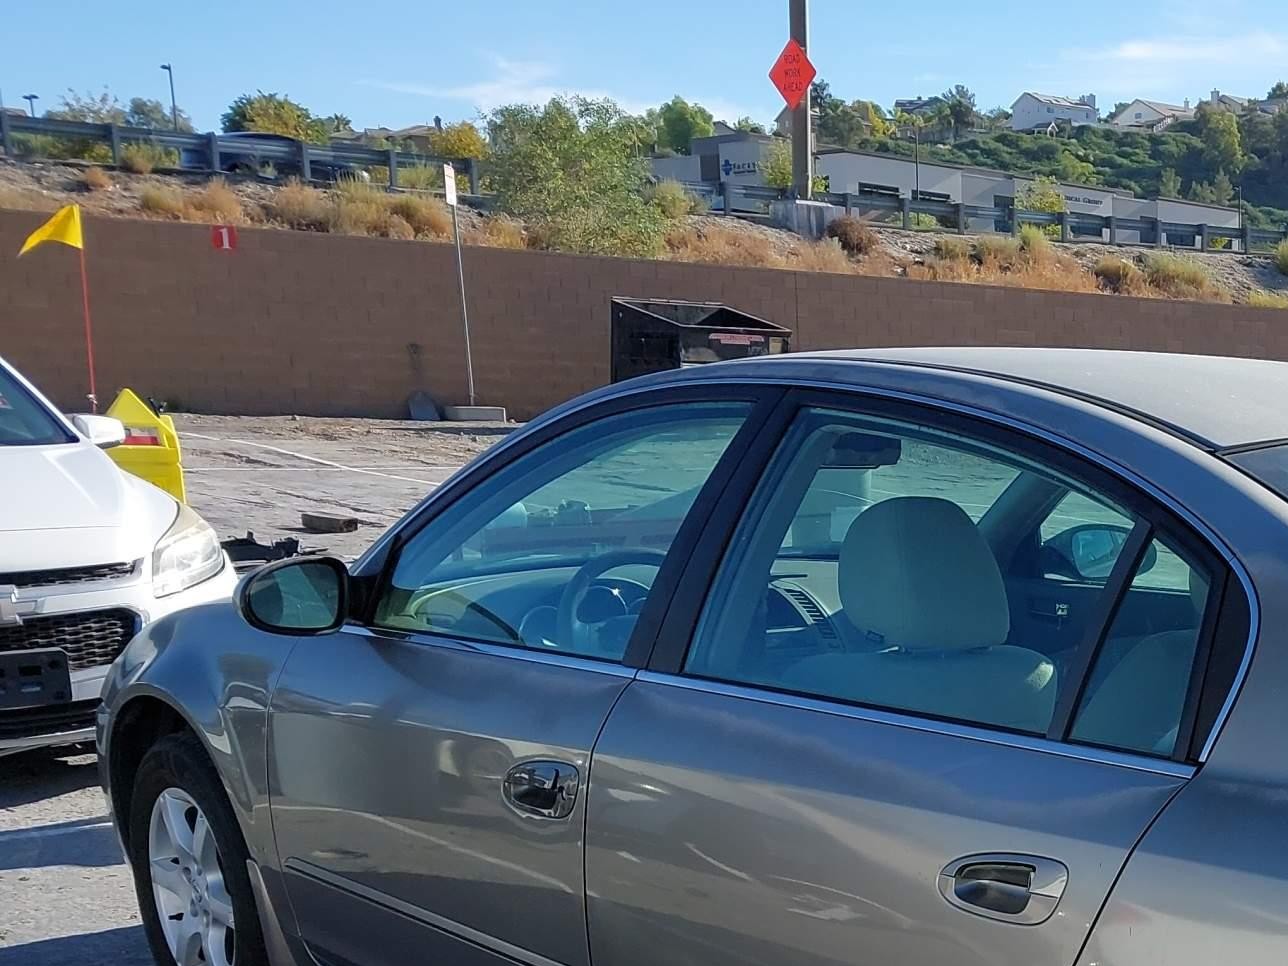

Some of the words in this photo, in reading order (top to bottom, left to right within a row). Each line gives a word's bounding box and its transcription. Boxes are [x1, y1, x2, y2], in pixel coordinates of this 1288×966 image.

[783, 53, 801, 64] ROAD
[783, 67, 801, 78] WORK
[783, 82, 803, 92] AHEAD
[218, 227, 232, 250] 1
